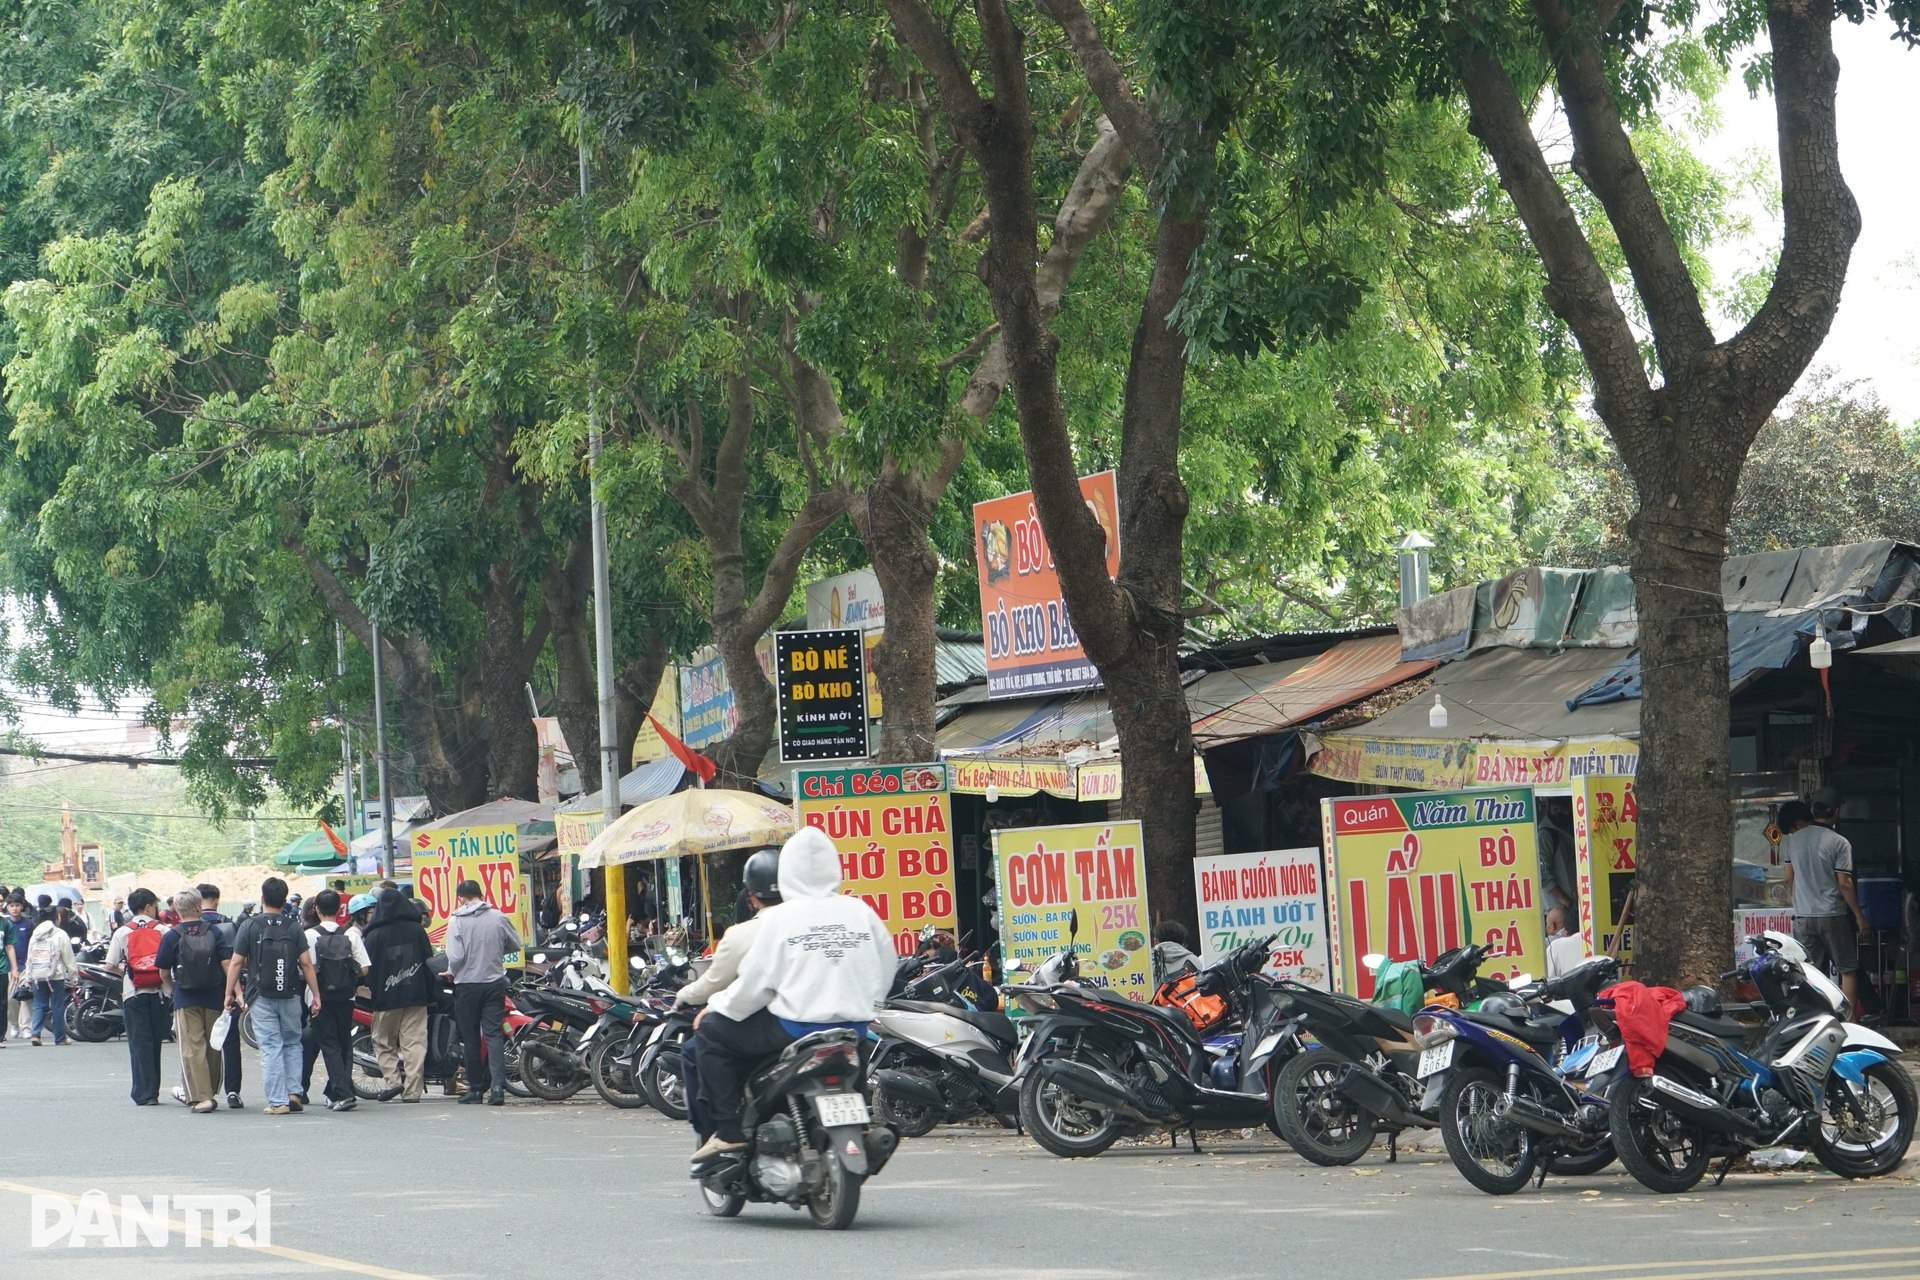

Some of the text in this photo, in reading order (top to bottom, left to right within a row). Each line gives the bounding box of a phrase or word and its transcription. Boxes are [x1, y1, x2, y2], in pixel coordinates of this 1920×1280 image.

[988, 594, 1080, 658] BÒ KHO BÁ
[791, 646, 819, 672] BÒ
[823, 645, 848, 669] NÉ
[792, 681, 852, 700] BÒ KHO
[796, 710, 852, 722] KÍNH MỜI
[1427, 745, 1441, 760] QUE
[1476, 748, 1639, 783] BÁNH XÈO MIỀN TRU
[851, 769, 900, 795] Béo
[991, 768, 1010, 788] BÚN
[1035, 767, 1049, 788] HÀ
[1082, 769, 1117, 795] BÚN BÒ
[1375, 762, 1389, 779] BÚN
[1389, 766, 1403, 783] THỊT
[1343, 794, 1526, 827] Quán Năm Thìn
[1595, 782, 1637, 824] BÁ
[805, 795, 946, 840] BÚN CHẢ
[448, 829, 516, 859] TẤN LỰC
[1479, 828, 1517, 868] BÒ
[838, 840, 949, 881] HỞ BÒ
[1008, 828, 1137, 907] CƠM TẤM
[478, 862, 517, 914] XE
[1201, 856, 1317, 902] BÁNH CUỐN NÓNG
[1470, 873, 1533, 912] THÁI
[901, 882, 954, 920] BÒ
[1012, 911, 1037, 925] SƯỜN
[1046, 912, 1058, 924] BA
[1101, 903, 1139, 931] 25K
[1205, 900, 1316, 930] BÁNH ƯỚT
[1348, 832, 1461, 1000] LẨU
[1745, 910, 1792, 934] BÁNH CUỐN
[803, 940, 861, 951] DEPARTMENT
[831, 931, 872, 941] CULTURE
[1013, 929, 1059, 943] SƯỜN QUE
[1276, 926, 1315, 949] Vy
[1486, 920, 1524, 959] CÁ
[1014, 946, 1034, 959] BÚN
[1272, 950, 1305, 968] 25K
[276, 958, 284, 992] adidas
[1130, 972, 1146, 986] 5K
[1128, 991, 1146, 1002] Phí
